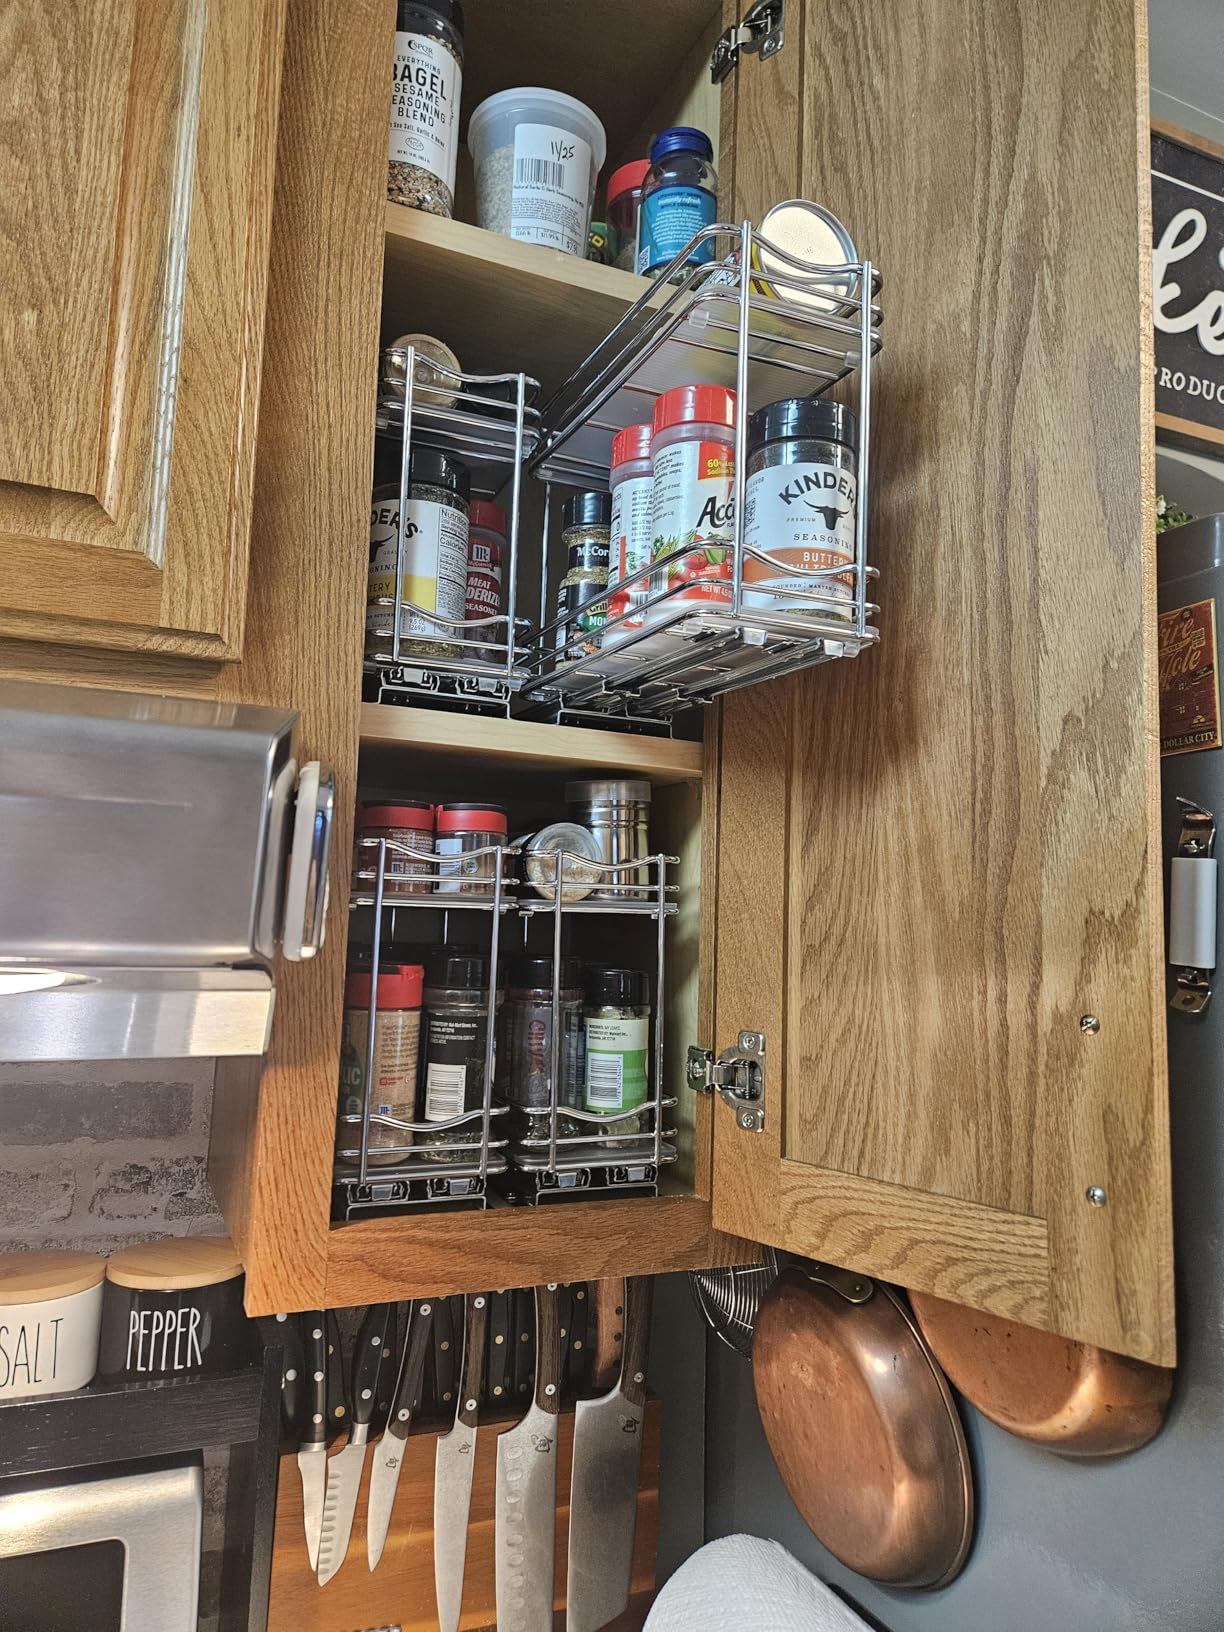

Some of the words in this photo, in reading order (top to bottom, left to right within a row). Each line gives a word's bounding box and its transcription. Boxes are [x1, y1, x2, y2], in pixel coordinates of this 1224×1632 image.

[397, 55, 441, 75] EVERYTHING
[394, 82, 440, 108] SESAME
[397, 106, 434, 127] BLEND
[468, 576, 491, 589] MEAT
[1163, 735, 1195, 749] DOLLAR
[1195, 731, 1215, 744] CITY
[126, 1307, 203, 1372] PEPPER
[0, 1317, 65, 1388] SALT
